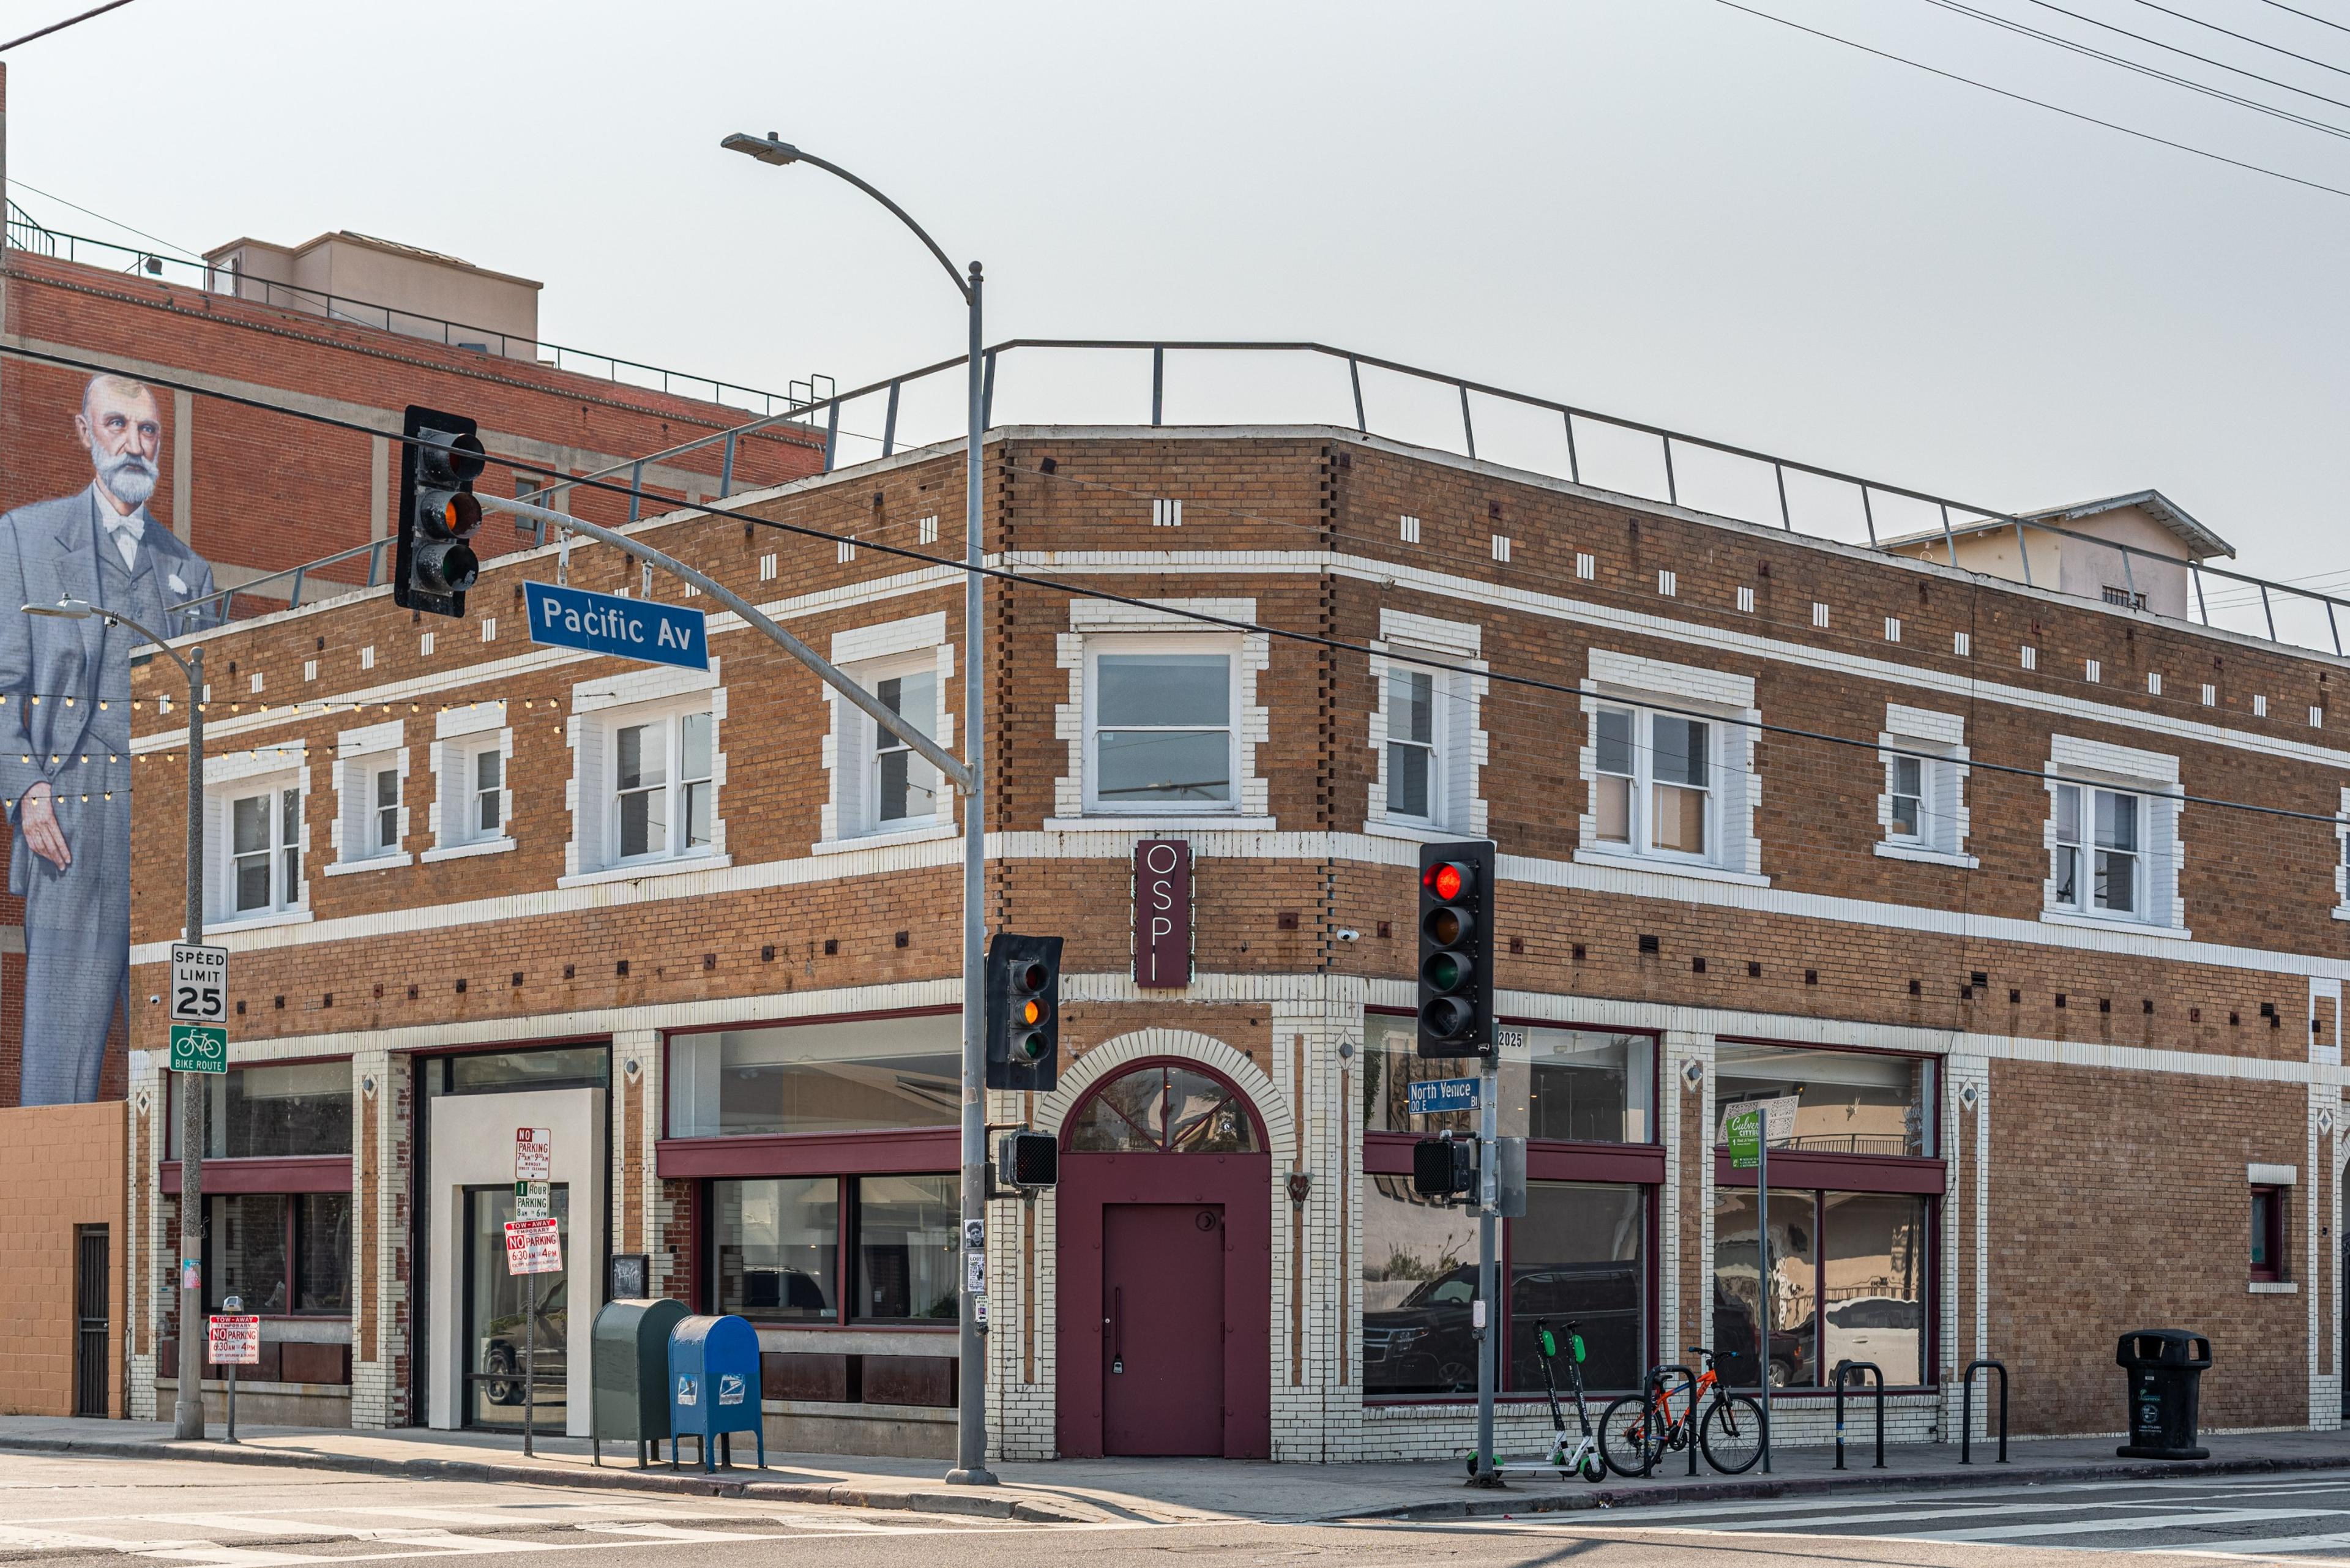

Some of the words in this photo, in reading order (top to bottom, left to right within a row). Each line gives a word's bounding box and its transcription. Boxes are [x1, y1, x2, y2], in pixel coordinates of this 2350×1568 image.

[542, 597, 644, 643] Pacific
[658, 618, 690, 650] Av
[176, 951, 224, 966] SPEED
[181, 969, 220, 982] LIMIT
[177, 987, 221, 1015] 25
[1499, 1032, 1522, 1047] 2025
[176, 1059, 193, 1069] BIKE
[196, 1060, 222, 1070] ROUTE
[1411, 1084, 1436, 1100] North
[1441, 1083, 1471, 1098] Venice
[1423, 1100, 1427, 1111] E
[519, 1130, 530, 1140] NO
[519, 1143, 548, 1153] PARKING
[521, 1183, 524, 1194] 1
[529, 1185, 546, 1195] HOUR
[518, 1198, 546, 1208] PARKING
[509, 1236, 524, 1249] NO
[526, 1235, 556, 1247] PARKING
[212, 1329, 226, 1340] NO
[228, 1331, 256, 1340] PARKING
